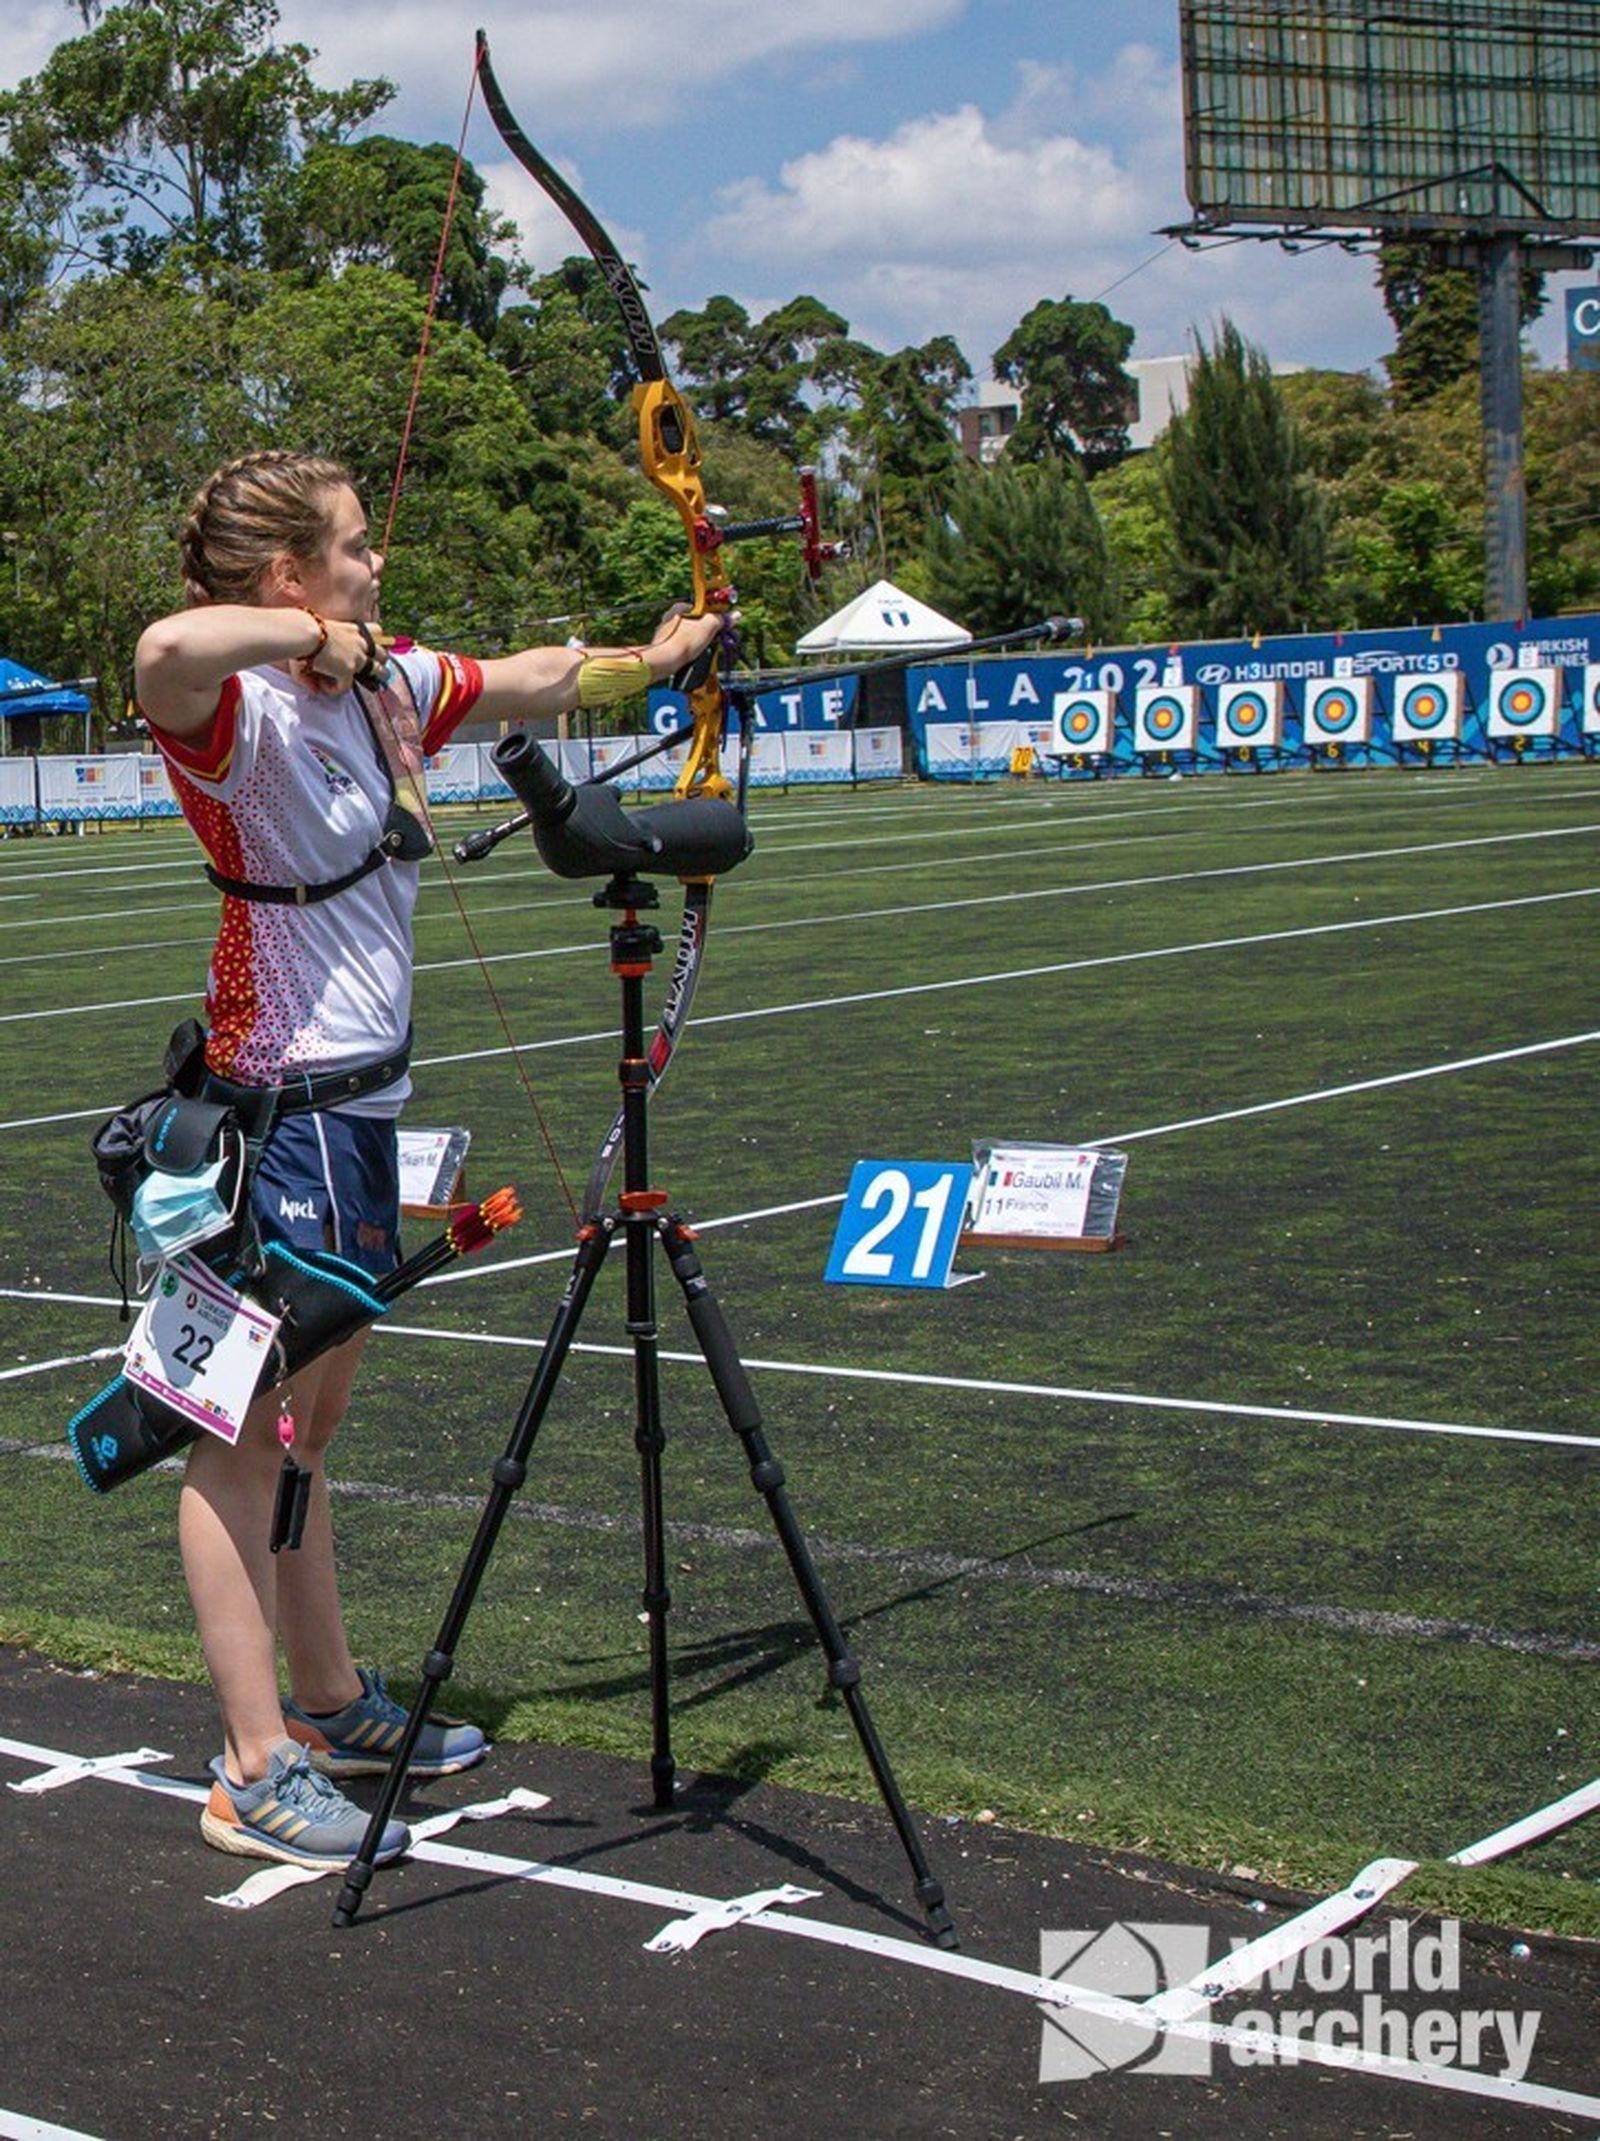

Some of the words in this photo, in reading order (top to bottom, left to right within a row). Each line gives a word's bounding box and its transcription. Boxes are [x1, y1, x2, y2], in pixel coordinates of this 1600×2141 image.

[1573, 299, 1600, 335] C
[1235, 661, 1325, 680] HUNDAI
[1249, 662, 1260, 679] 3
[1427, 656, 1440, 671] 5
[1012, 1171, 1063, 1189] Gaubil
[1066, 1172, 1084, 1189] M.
[279, 1195, 318, 1223] NKL
[985, 1198, 1003, 1215] 11
[1005, 1198, 1049, 1212] France
[843, 1169, 954, 1279] 21
[171, 1324, 215, 1376] 22
